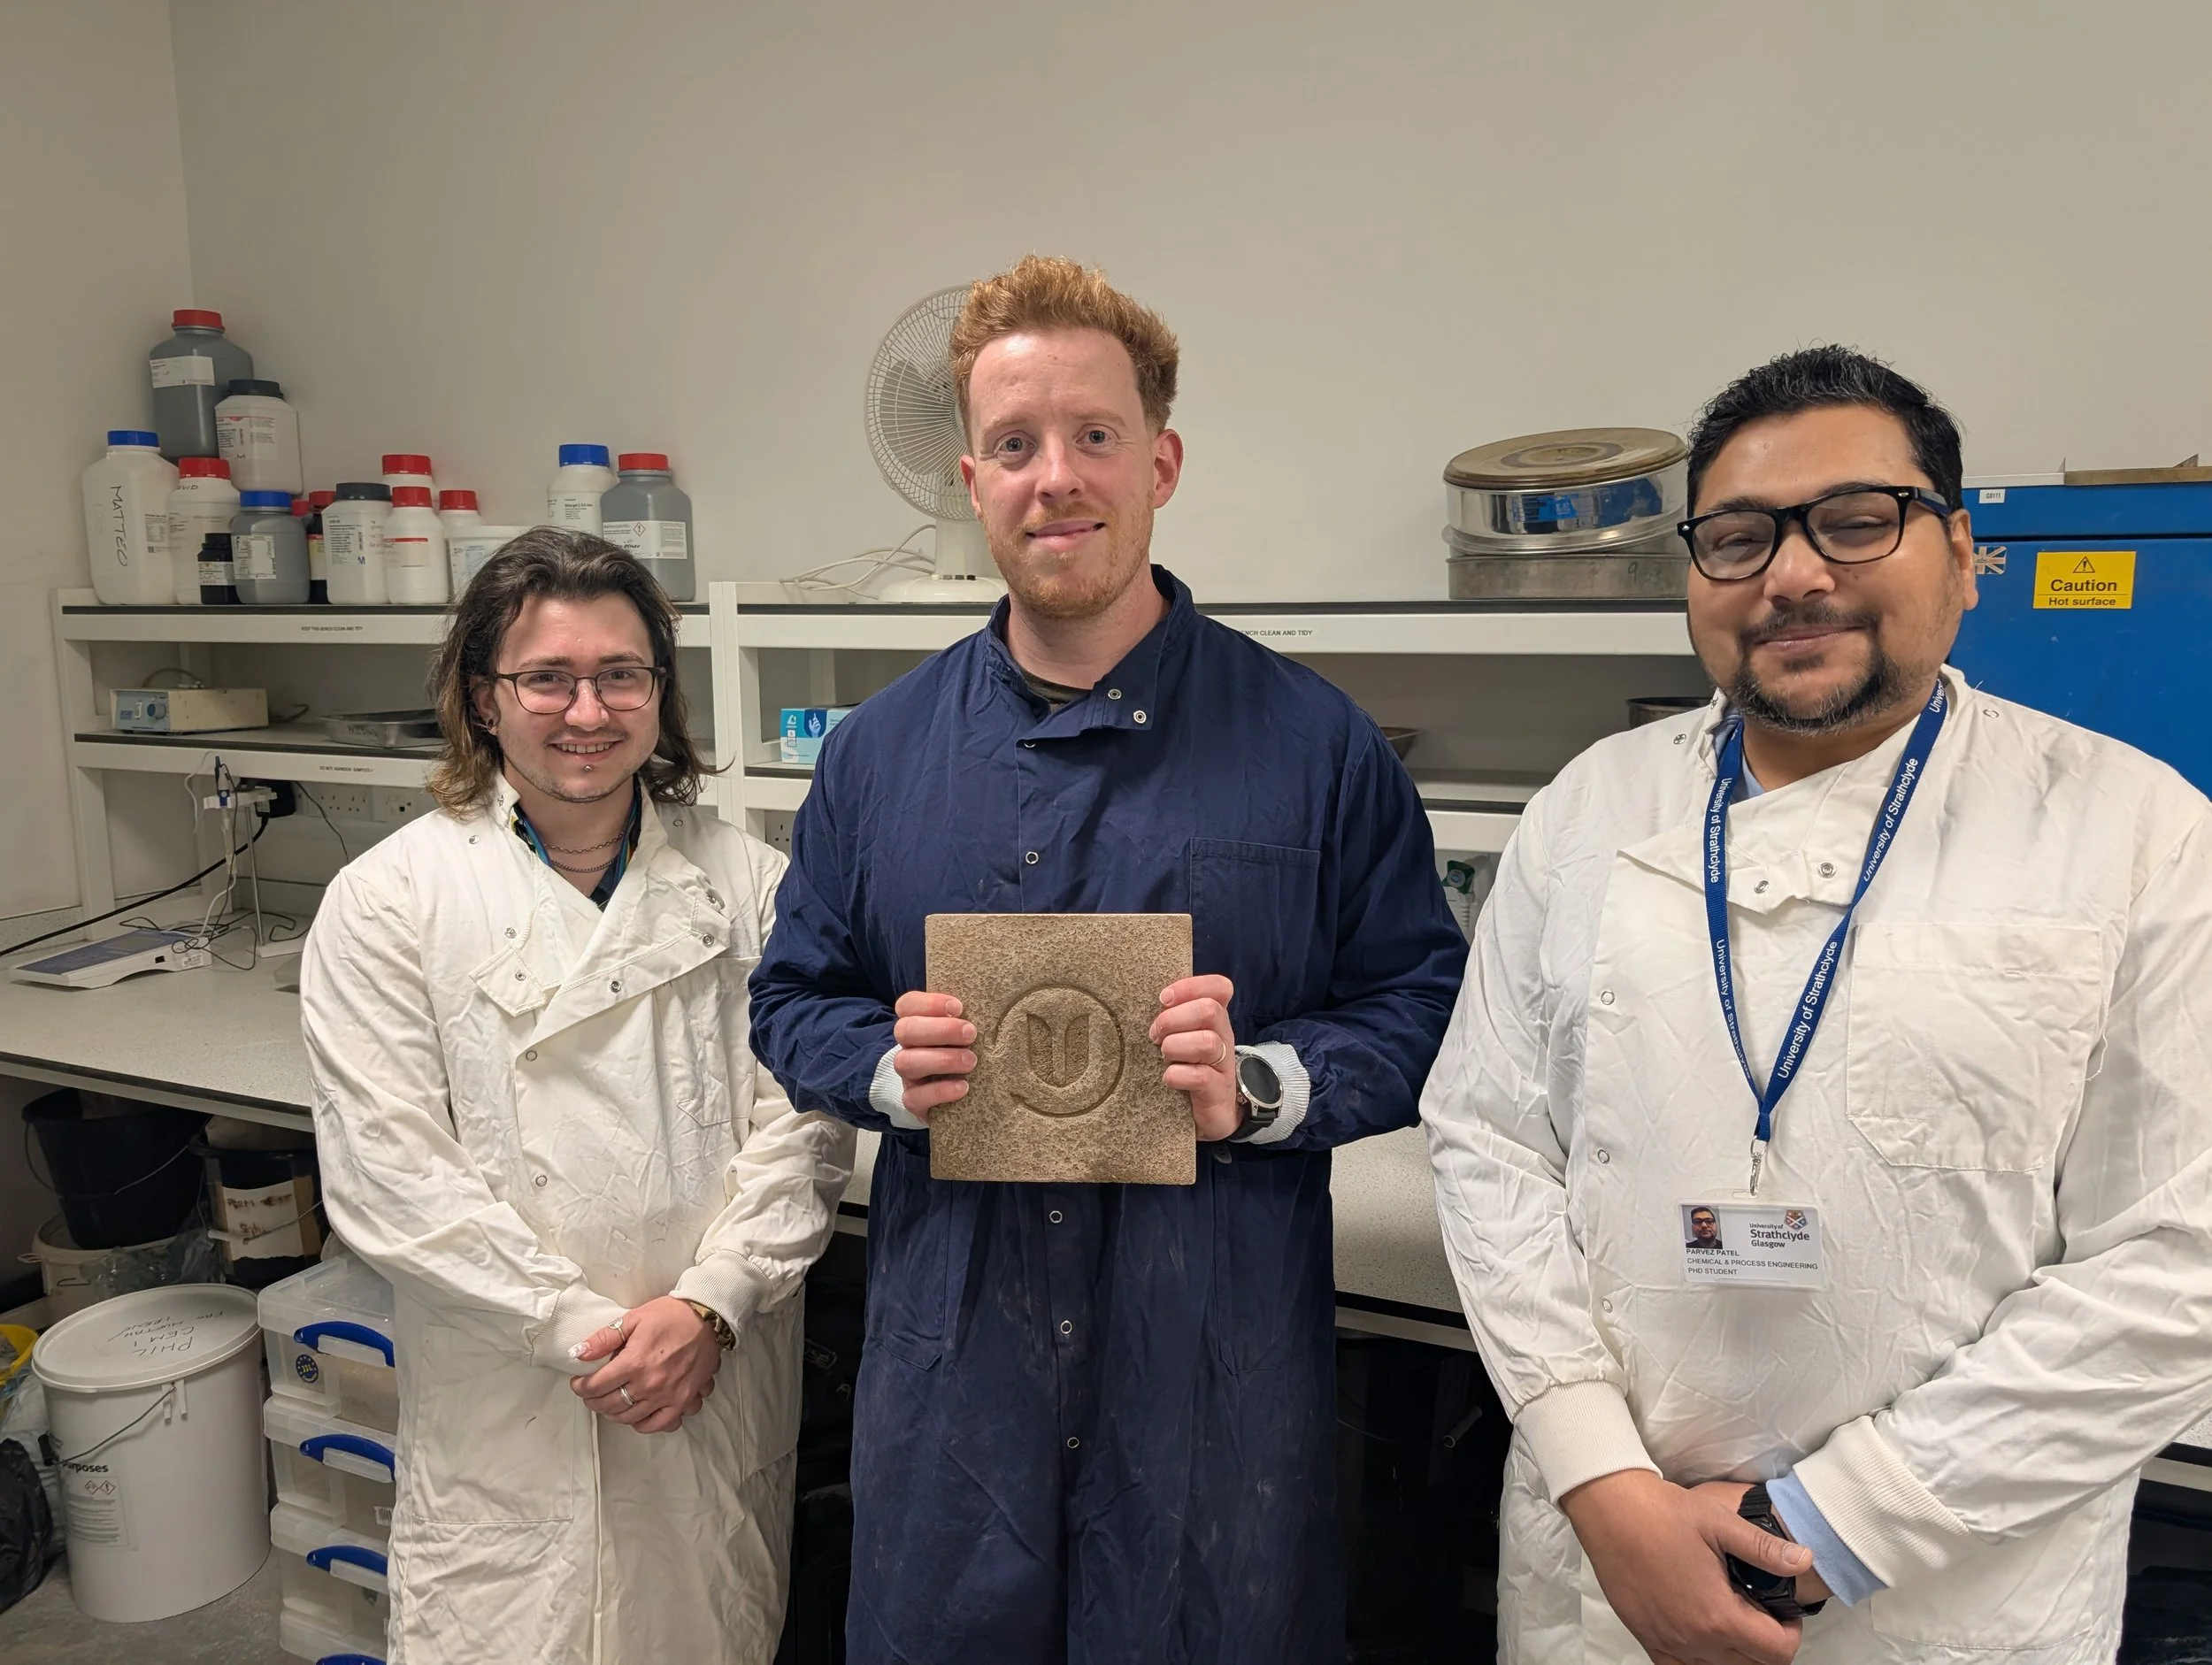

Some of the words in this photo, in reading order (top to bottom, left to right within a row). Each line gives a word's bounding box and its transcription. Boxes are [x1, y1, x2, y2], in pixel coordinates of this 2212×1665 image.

[111, 485, 127, 566] MATTEO
[2050, 579, 2117, 592] Caution
[2048, 597, 2069, 606] Hot
[2072, 597, 2116, 606] surface
[1709, 778, 1733, 814] University
[1887, 758, 1919, 816] Strathclyde
[1710, 815, 1721, 825] of
[1885, 814, 1894, 829] of
[1708, 825, 1721, 883] Strathclyde
[1863, 828, 1891, 882] University
[1717, 939, 1728, 996] University
[1805, 941, 1838, 1005] Strathclyde
[1724, 999, 1732, 1010] of
[1802, 1005, 1814, 1020] of
[1727, 1013, 1751, 1079] Strathclyde
[1778, 1021, 1811, 1078] University
[1750, 1229, 1810, 1242] Strathclyde
[1751, 1239, 1786, 1248] Glasgow
[1767, 1261, 1818, 1270] ENGINEERING
[150, 1326, 195, 1343] CEM
[132, 1336, 193, 1356] PHIL
